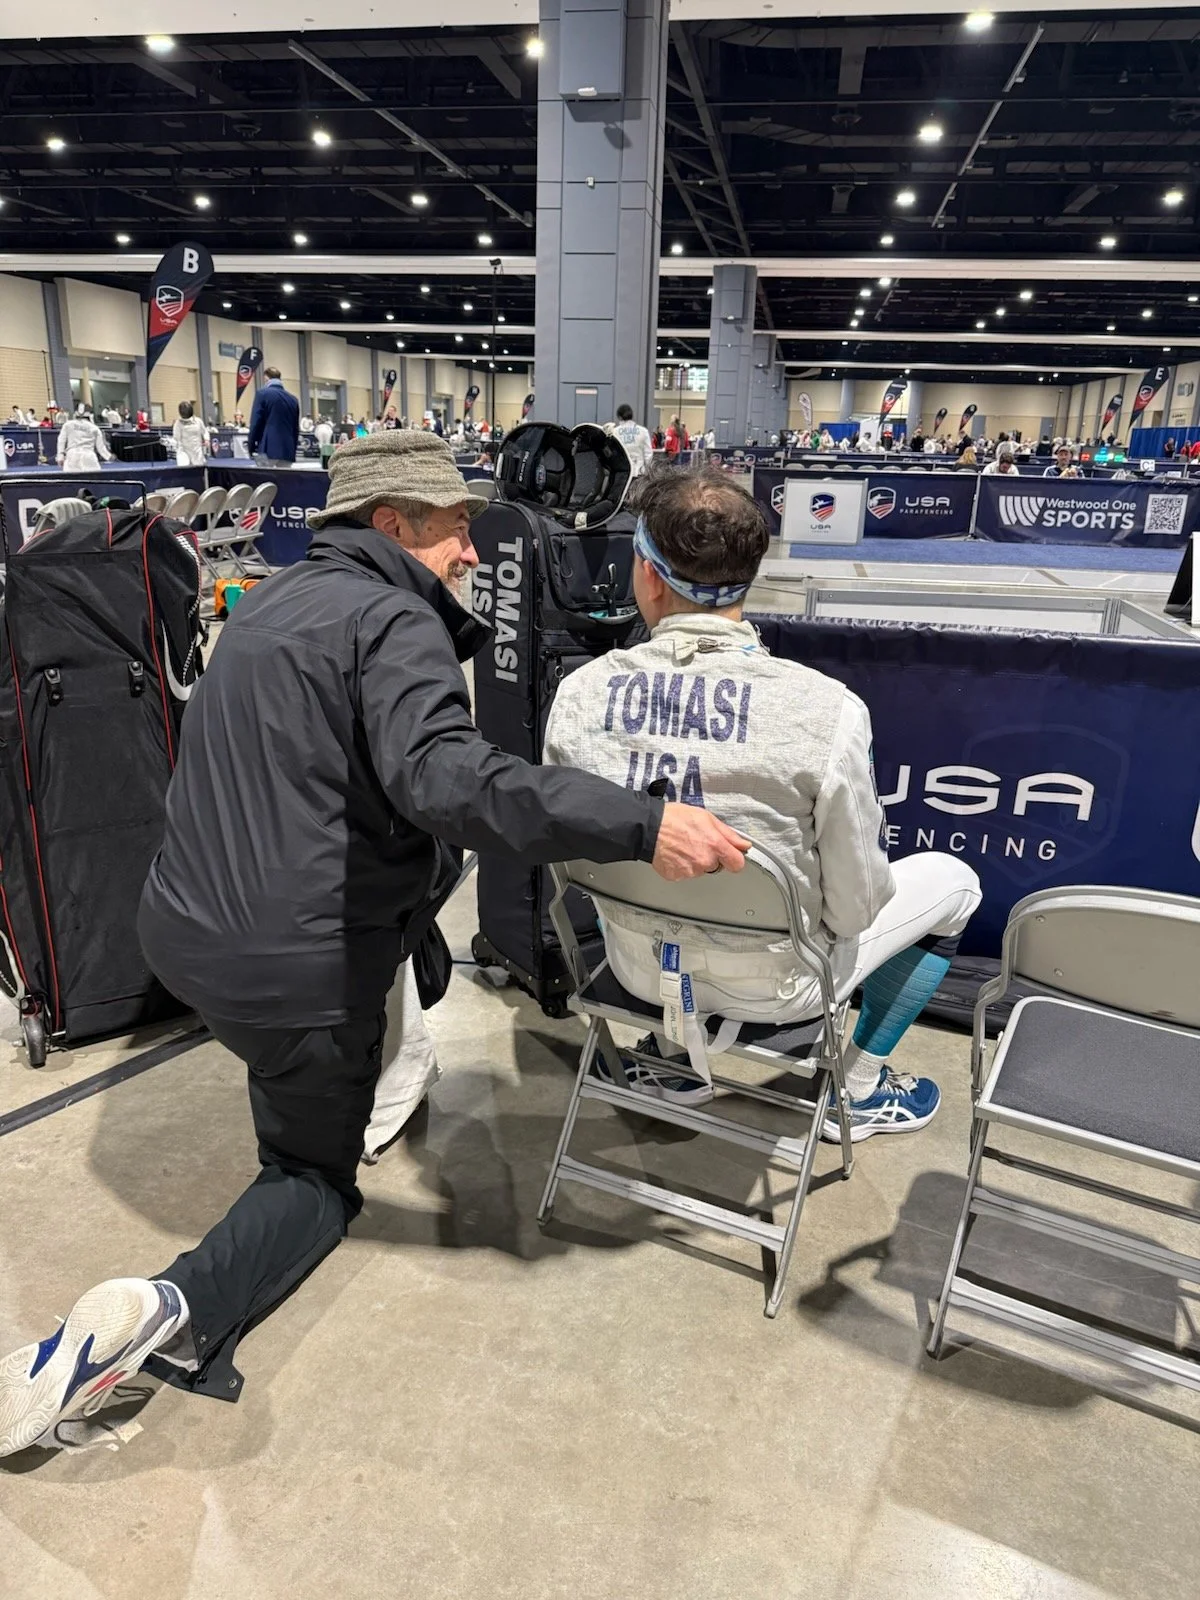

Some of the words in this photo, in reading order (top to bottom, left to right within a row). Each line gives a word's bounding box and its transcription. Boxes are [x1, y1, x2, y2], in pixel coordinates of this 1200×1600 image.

[183, 247, 199, 274] B
[250, 348, 257, 360] F
[1155, 367, 1164, 380] E
[905, 495, 950, 508] USA
[1046, 497, 1107, 511] Westwood
[1110, 501, 1137, 511] One
[276, 521, 309, 529] FENCI
[1042, 510, 1134, 529] SPORTS
[494, 536, 523, 683] TOMASI
[604, 671, 752, 744] TOMASI
[625, 751, 705, 809] USA
[886, 825, 1058, 861] ENCING
[682, 974, 694, 1013] NEGRINI
